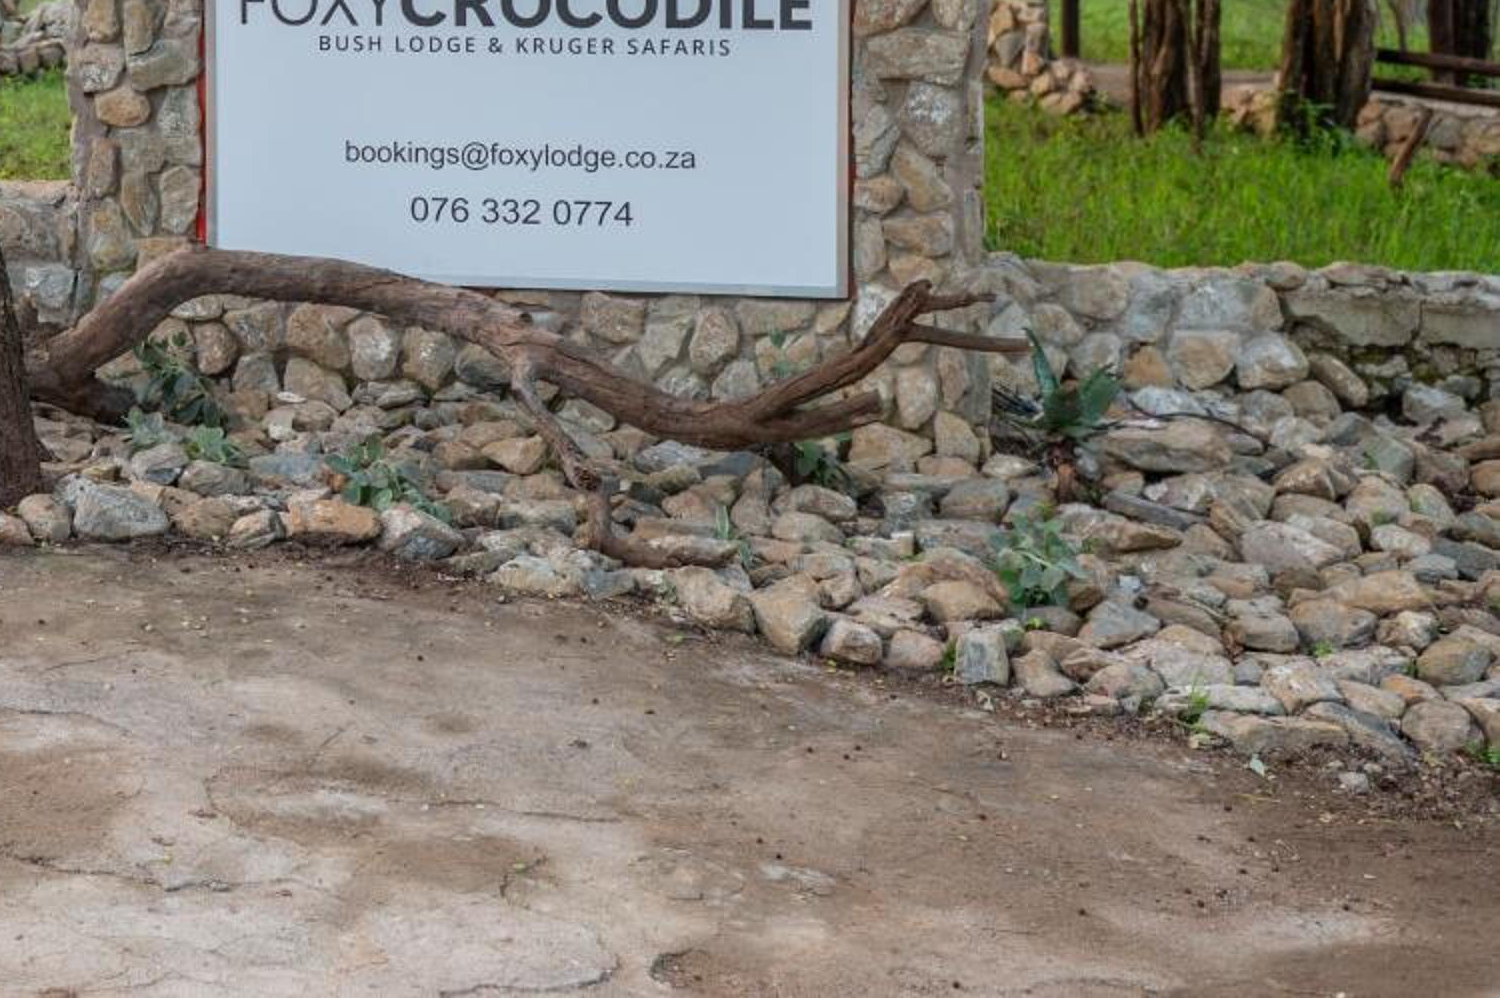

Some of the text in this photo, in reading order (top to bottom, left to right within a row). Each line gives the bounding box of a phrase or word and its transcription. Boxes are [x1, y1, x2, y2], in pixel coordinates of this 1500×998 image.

[318, 34, 732, 57] BUSH LODGE & KRUGER SAFARIS
[344, 139, 697, 173] bookings@foxylodge.co.za
[409, 195, 635, 228] 076 332 0774
